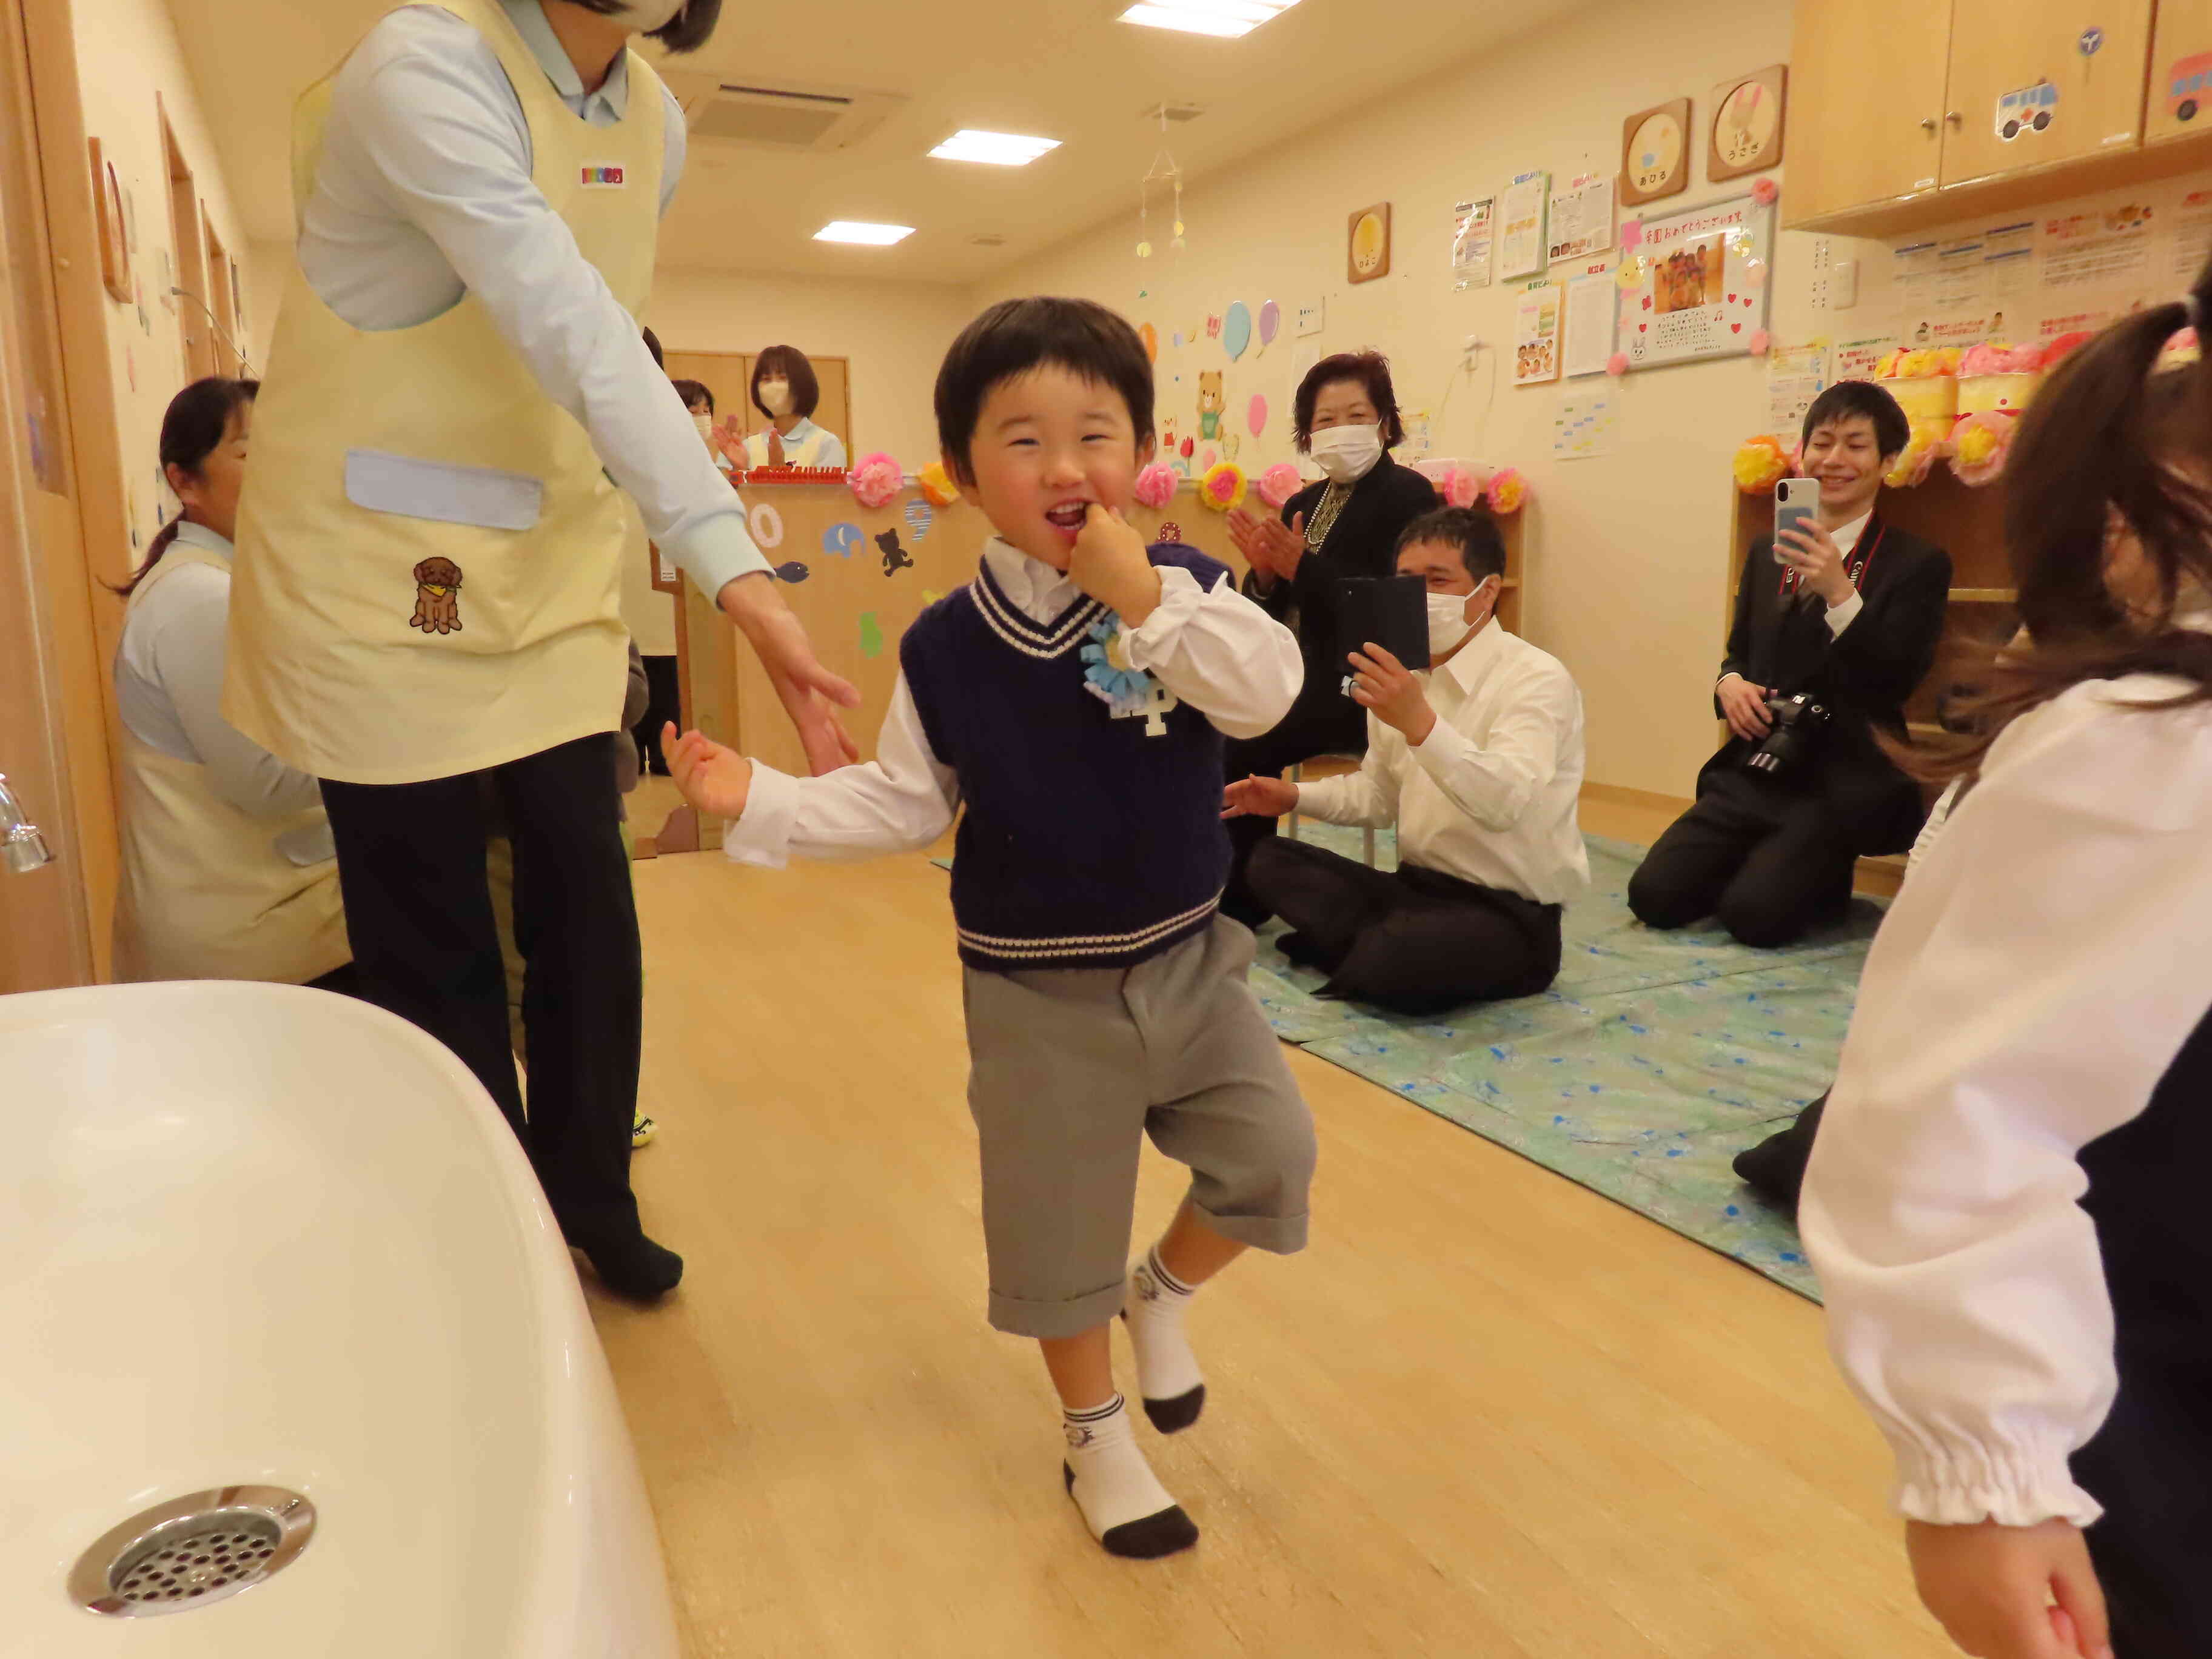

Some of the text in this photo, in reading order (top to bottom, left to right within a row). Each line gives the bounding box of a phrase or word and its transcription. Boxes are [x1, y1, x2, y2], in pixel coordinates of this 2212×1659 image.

[1728, 142, 1759, 160] うさぎ
[1640, 170, 1667, 186] あひる
[1646, 211, 1742, 244] 卒園おめでとうございます
[1359, 256, 1377, 268] ひよこ
